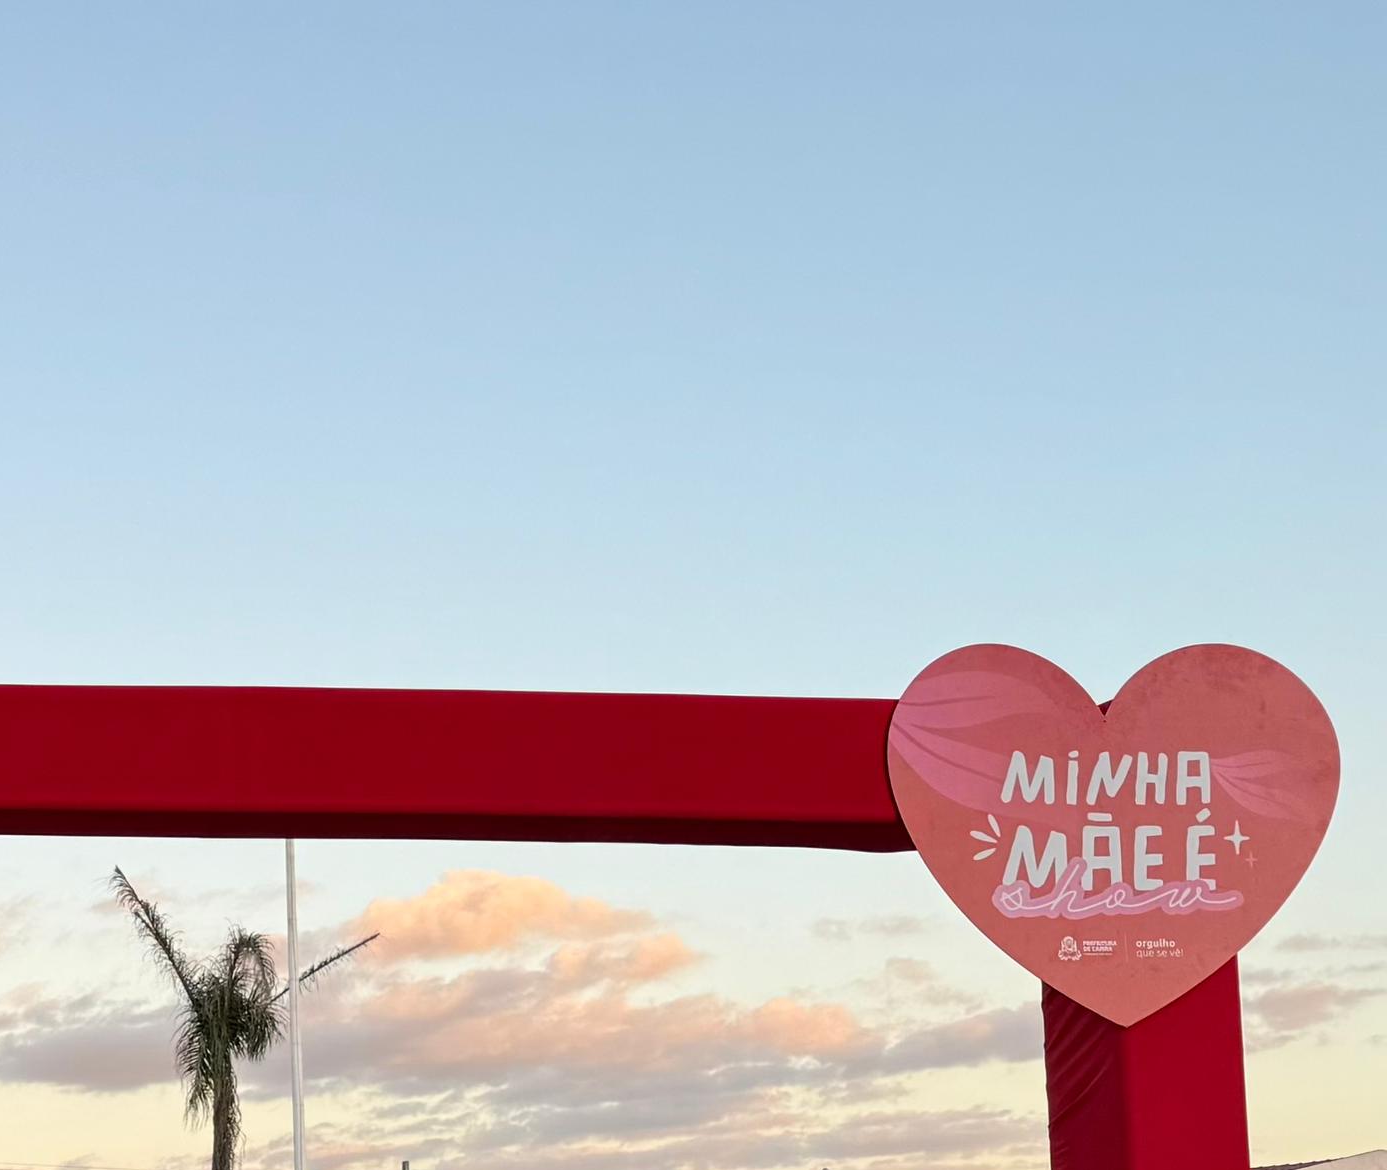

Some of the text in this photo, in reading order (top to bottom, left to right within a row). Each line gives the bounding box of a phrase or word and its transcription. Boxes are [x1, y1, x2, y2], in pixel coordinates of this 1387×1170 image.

[1000, 750, 1212, 806] MINHA
[1185, 807, 1217, 891] É
[994, 858, 1241, 919] show
[1135, 938, 1176, 950] orgulho
[1136, 949, 1154, 959] que
